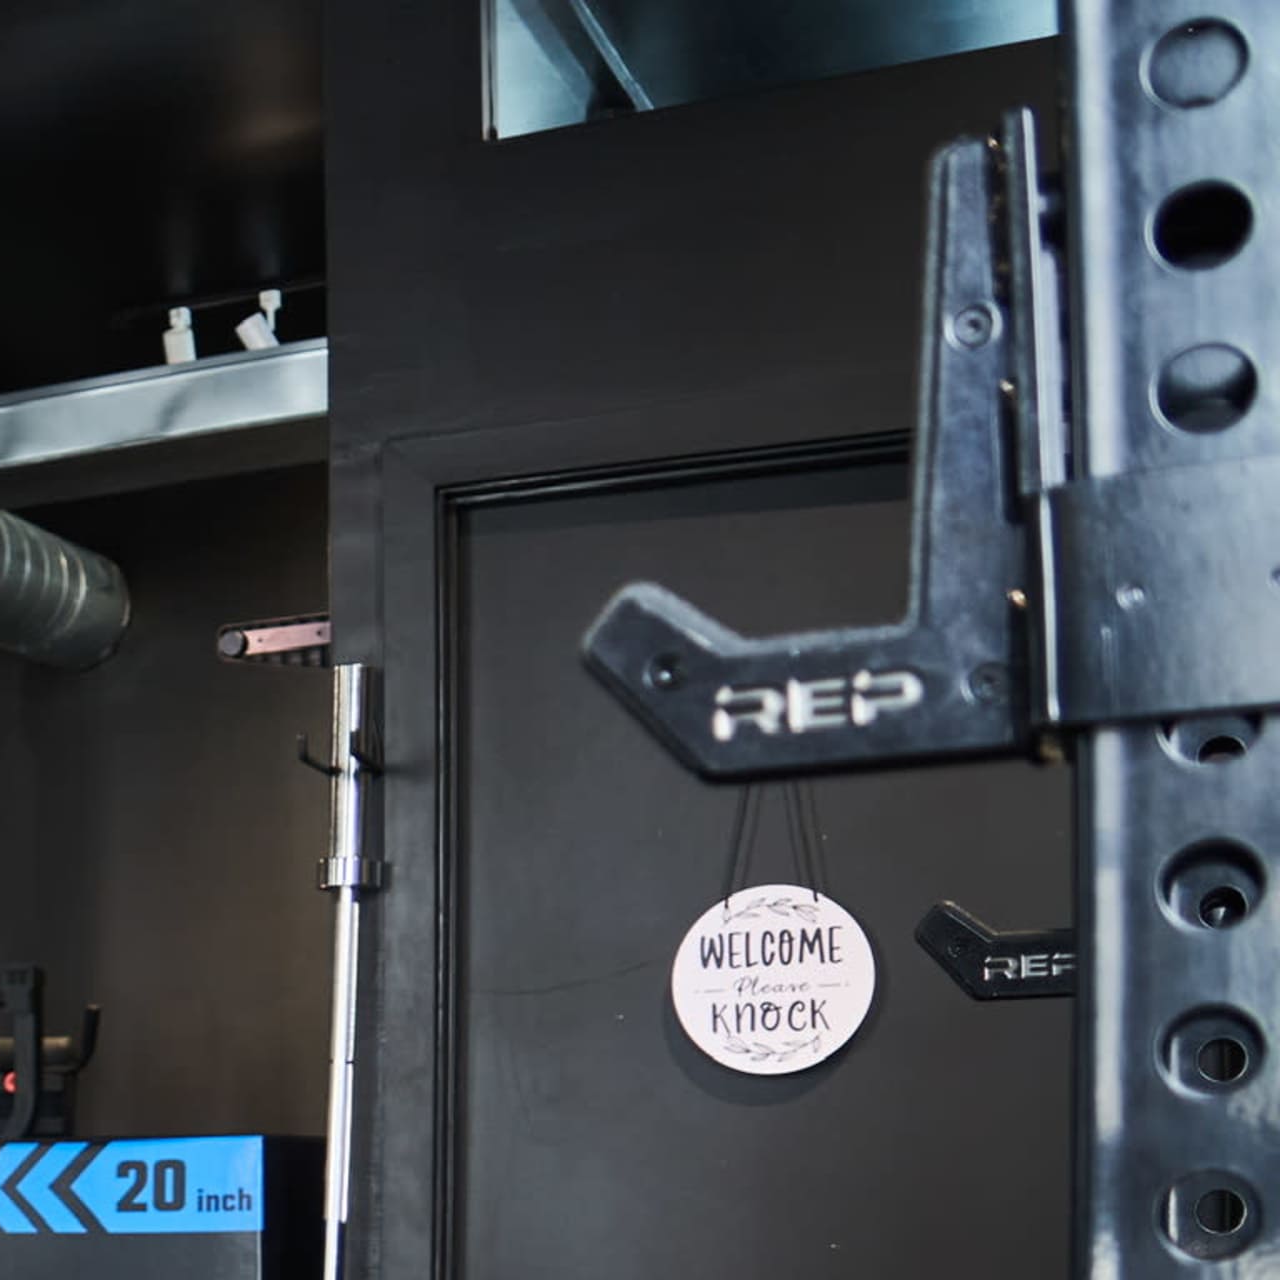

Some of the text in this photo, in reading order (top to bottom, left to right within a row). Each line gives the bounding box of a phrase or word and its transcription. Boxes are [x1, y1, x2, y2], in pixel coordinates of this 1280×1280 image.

[711, 668, 925, 742] REP
[700, 926, 843, 969] WELCOME
[733, 975, 811, 997] Please
[116, 1160, 252, 1212] 20 inch
